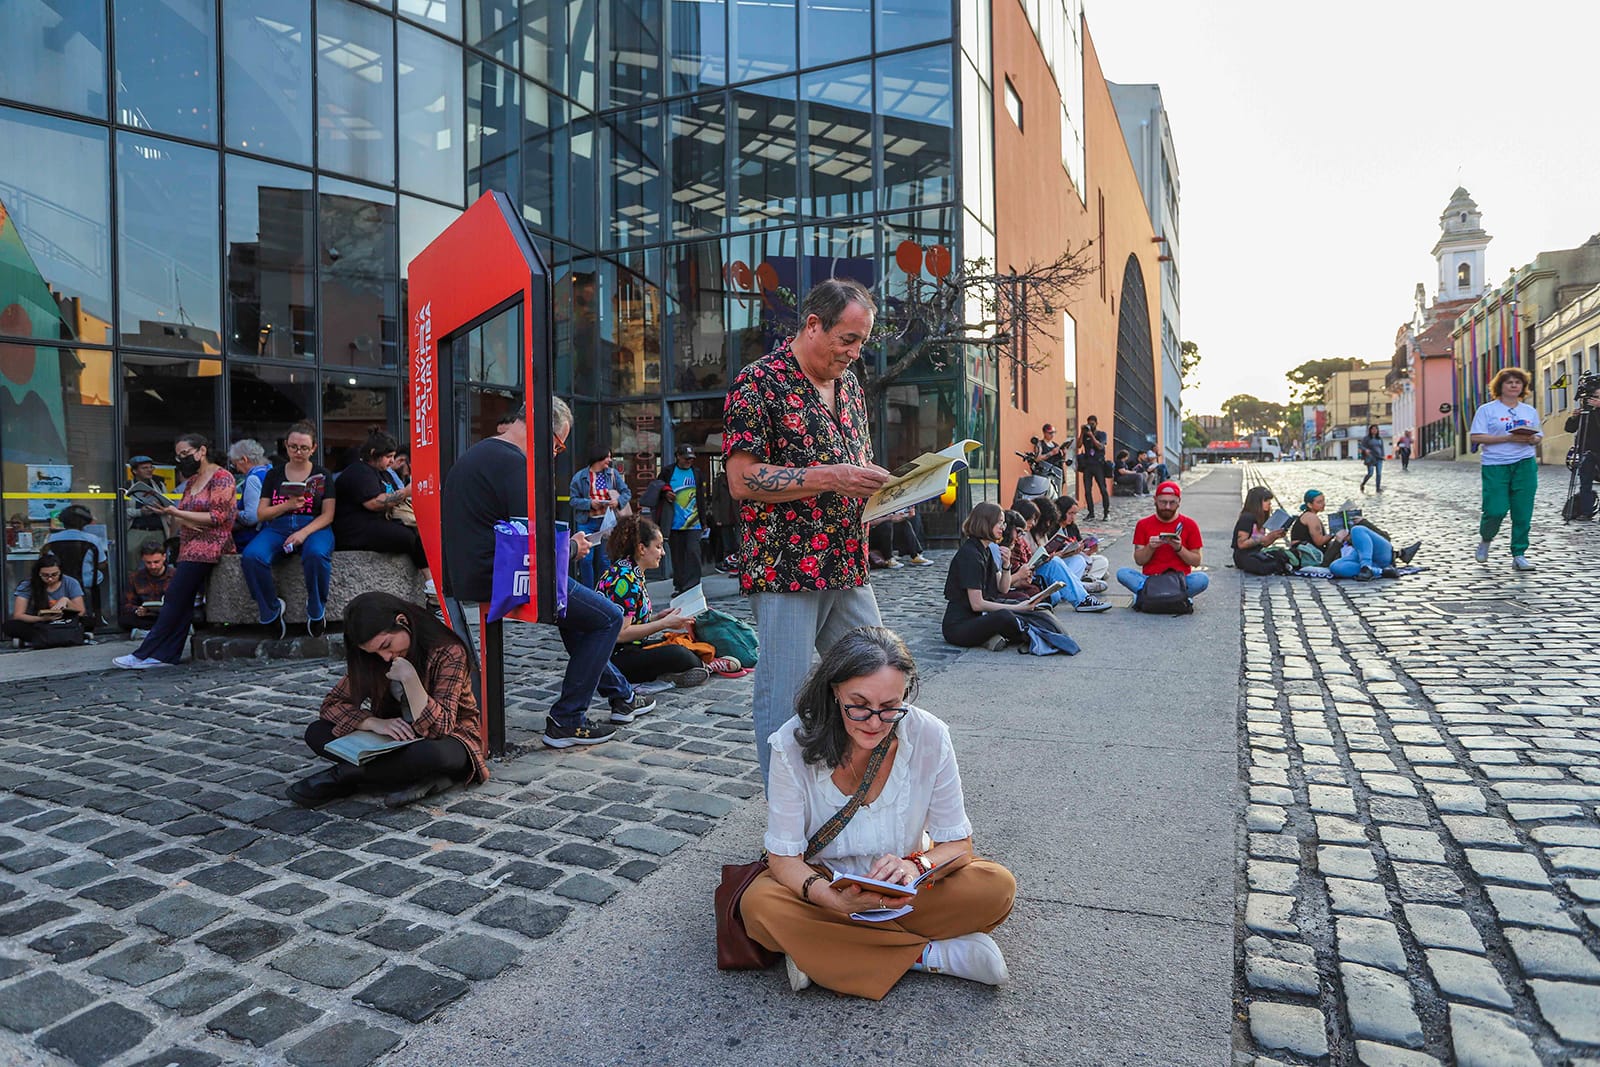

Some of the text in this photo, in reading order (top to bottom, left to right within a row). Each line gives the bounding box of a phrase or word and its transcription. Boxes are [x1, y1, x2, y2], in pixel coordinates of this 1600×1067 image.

[419, 303, 428, 447] PALAVRA
[425, 300, 434, 445] DE CURITIBA
